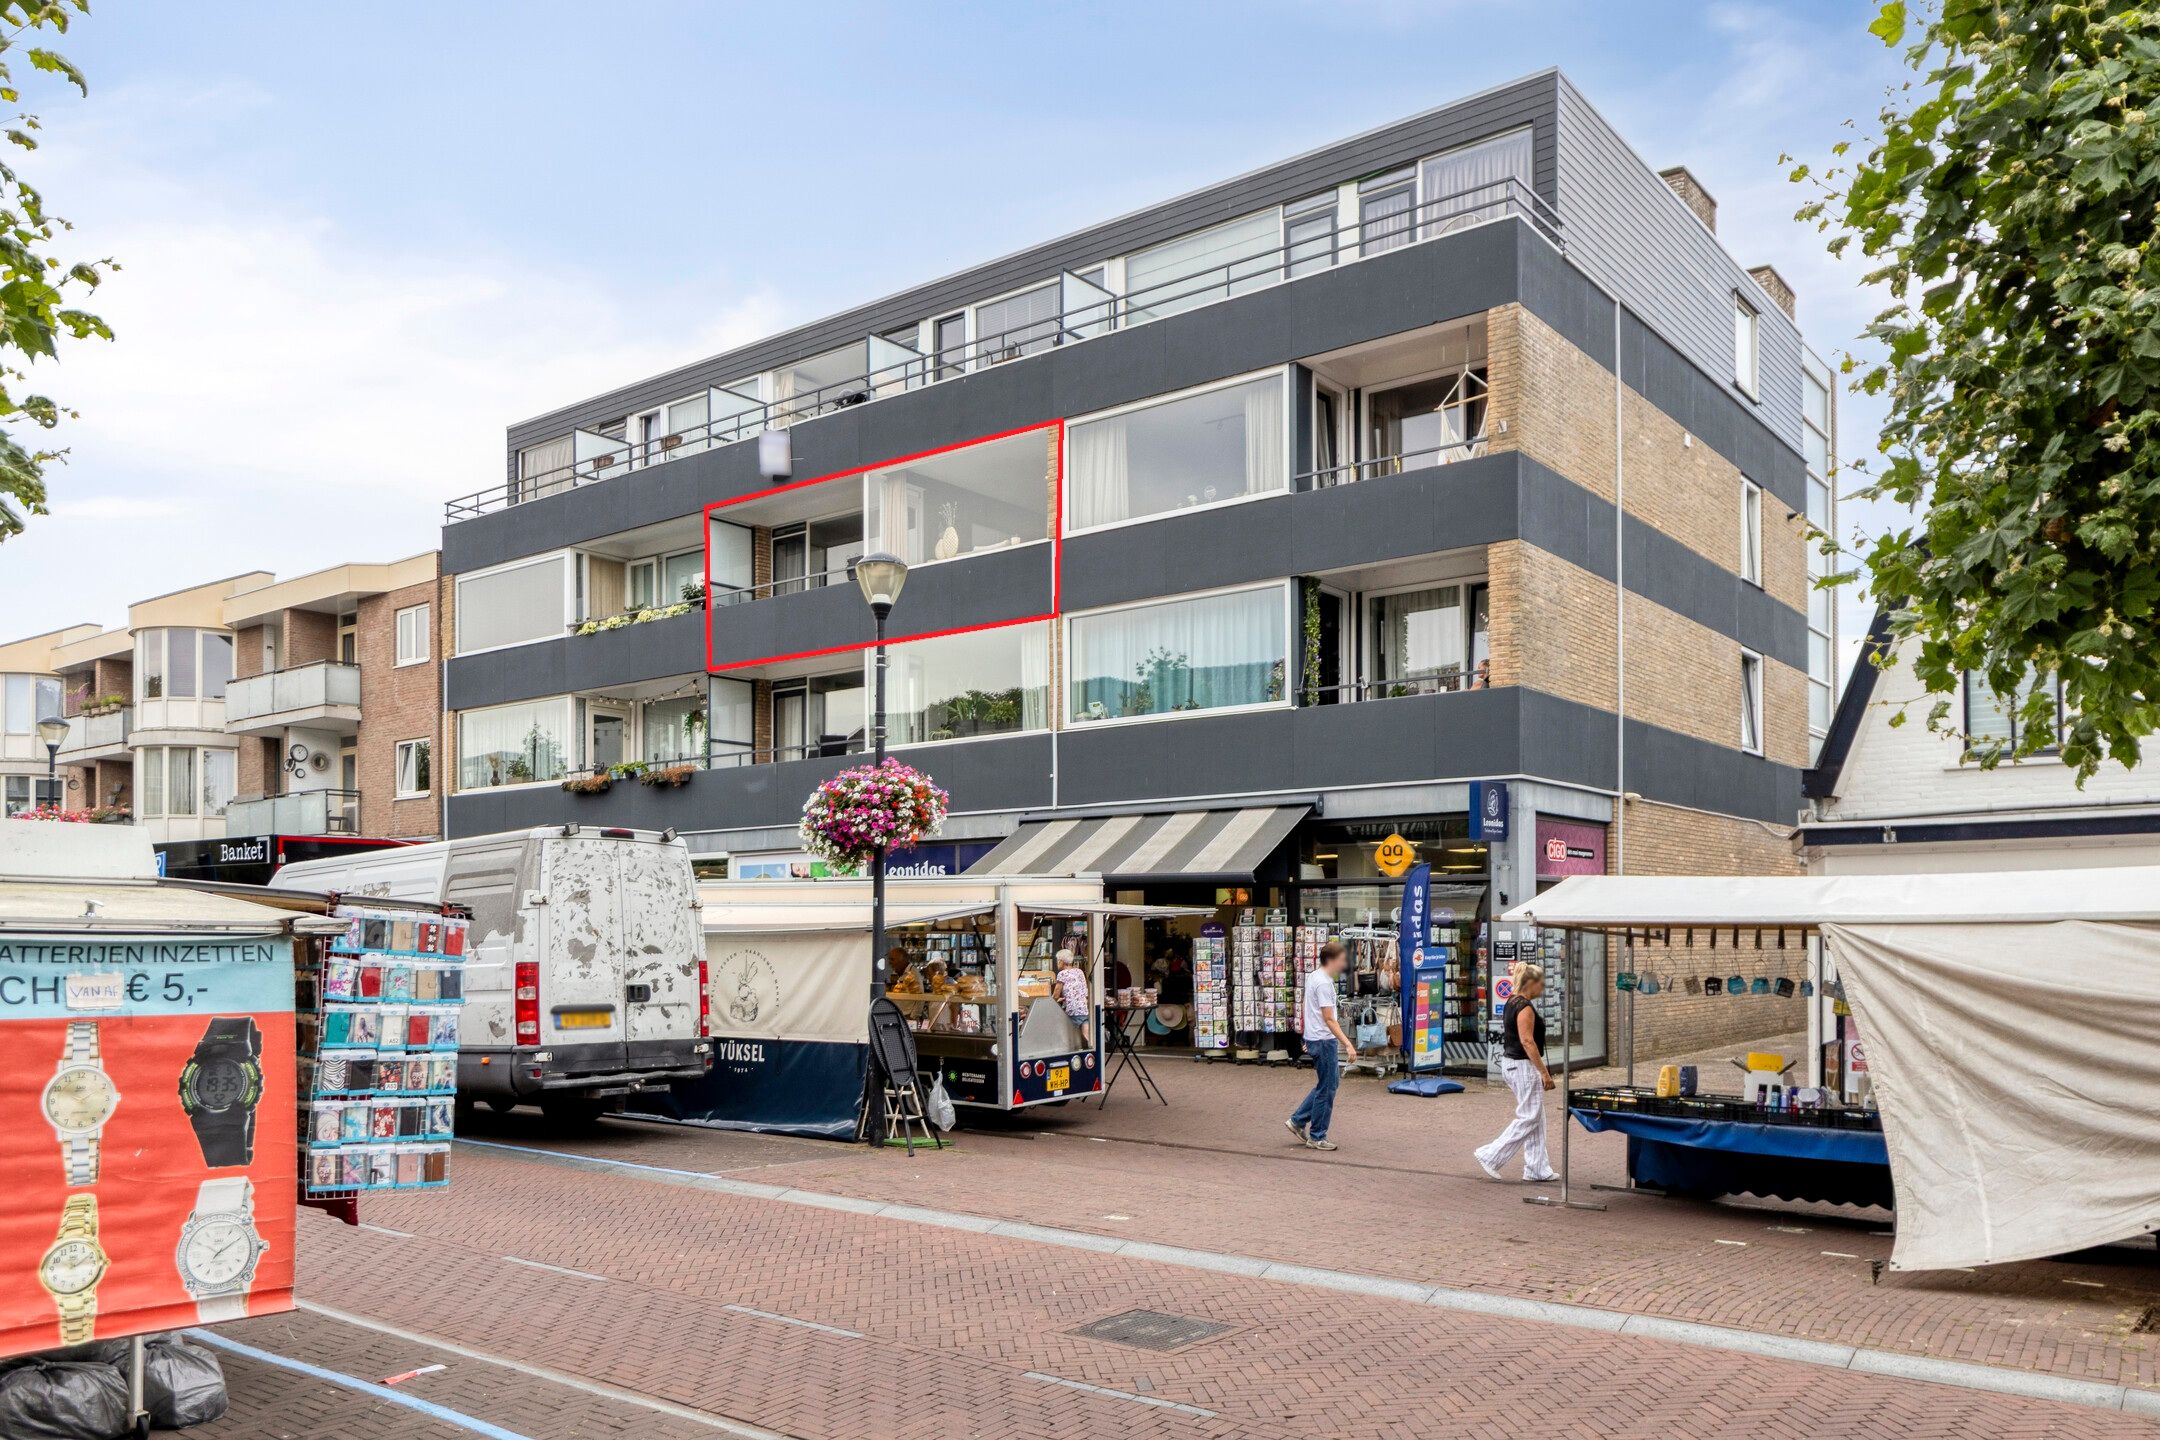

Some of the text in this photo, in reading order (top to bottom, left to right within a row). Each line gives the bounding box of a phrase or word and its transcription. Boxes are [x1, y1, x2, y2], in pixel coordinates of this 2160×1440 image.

[220, 842, 264, 862] Banket
[152, 944, 275, 962] INZETTEN
[0, 976, 69, 1005] CH
[162, 973, 209, 1007] 5,-
[720, 1040, 766, 1062] YÜKSEL
